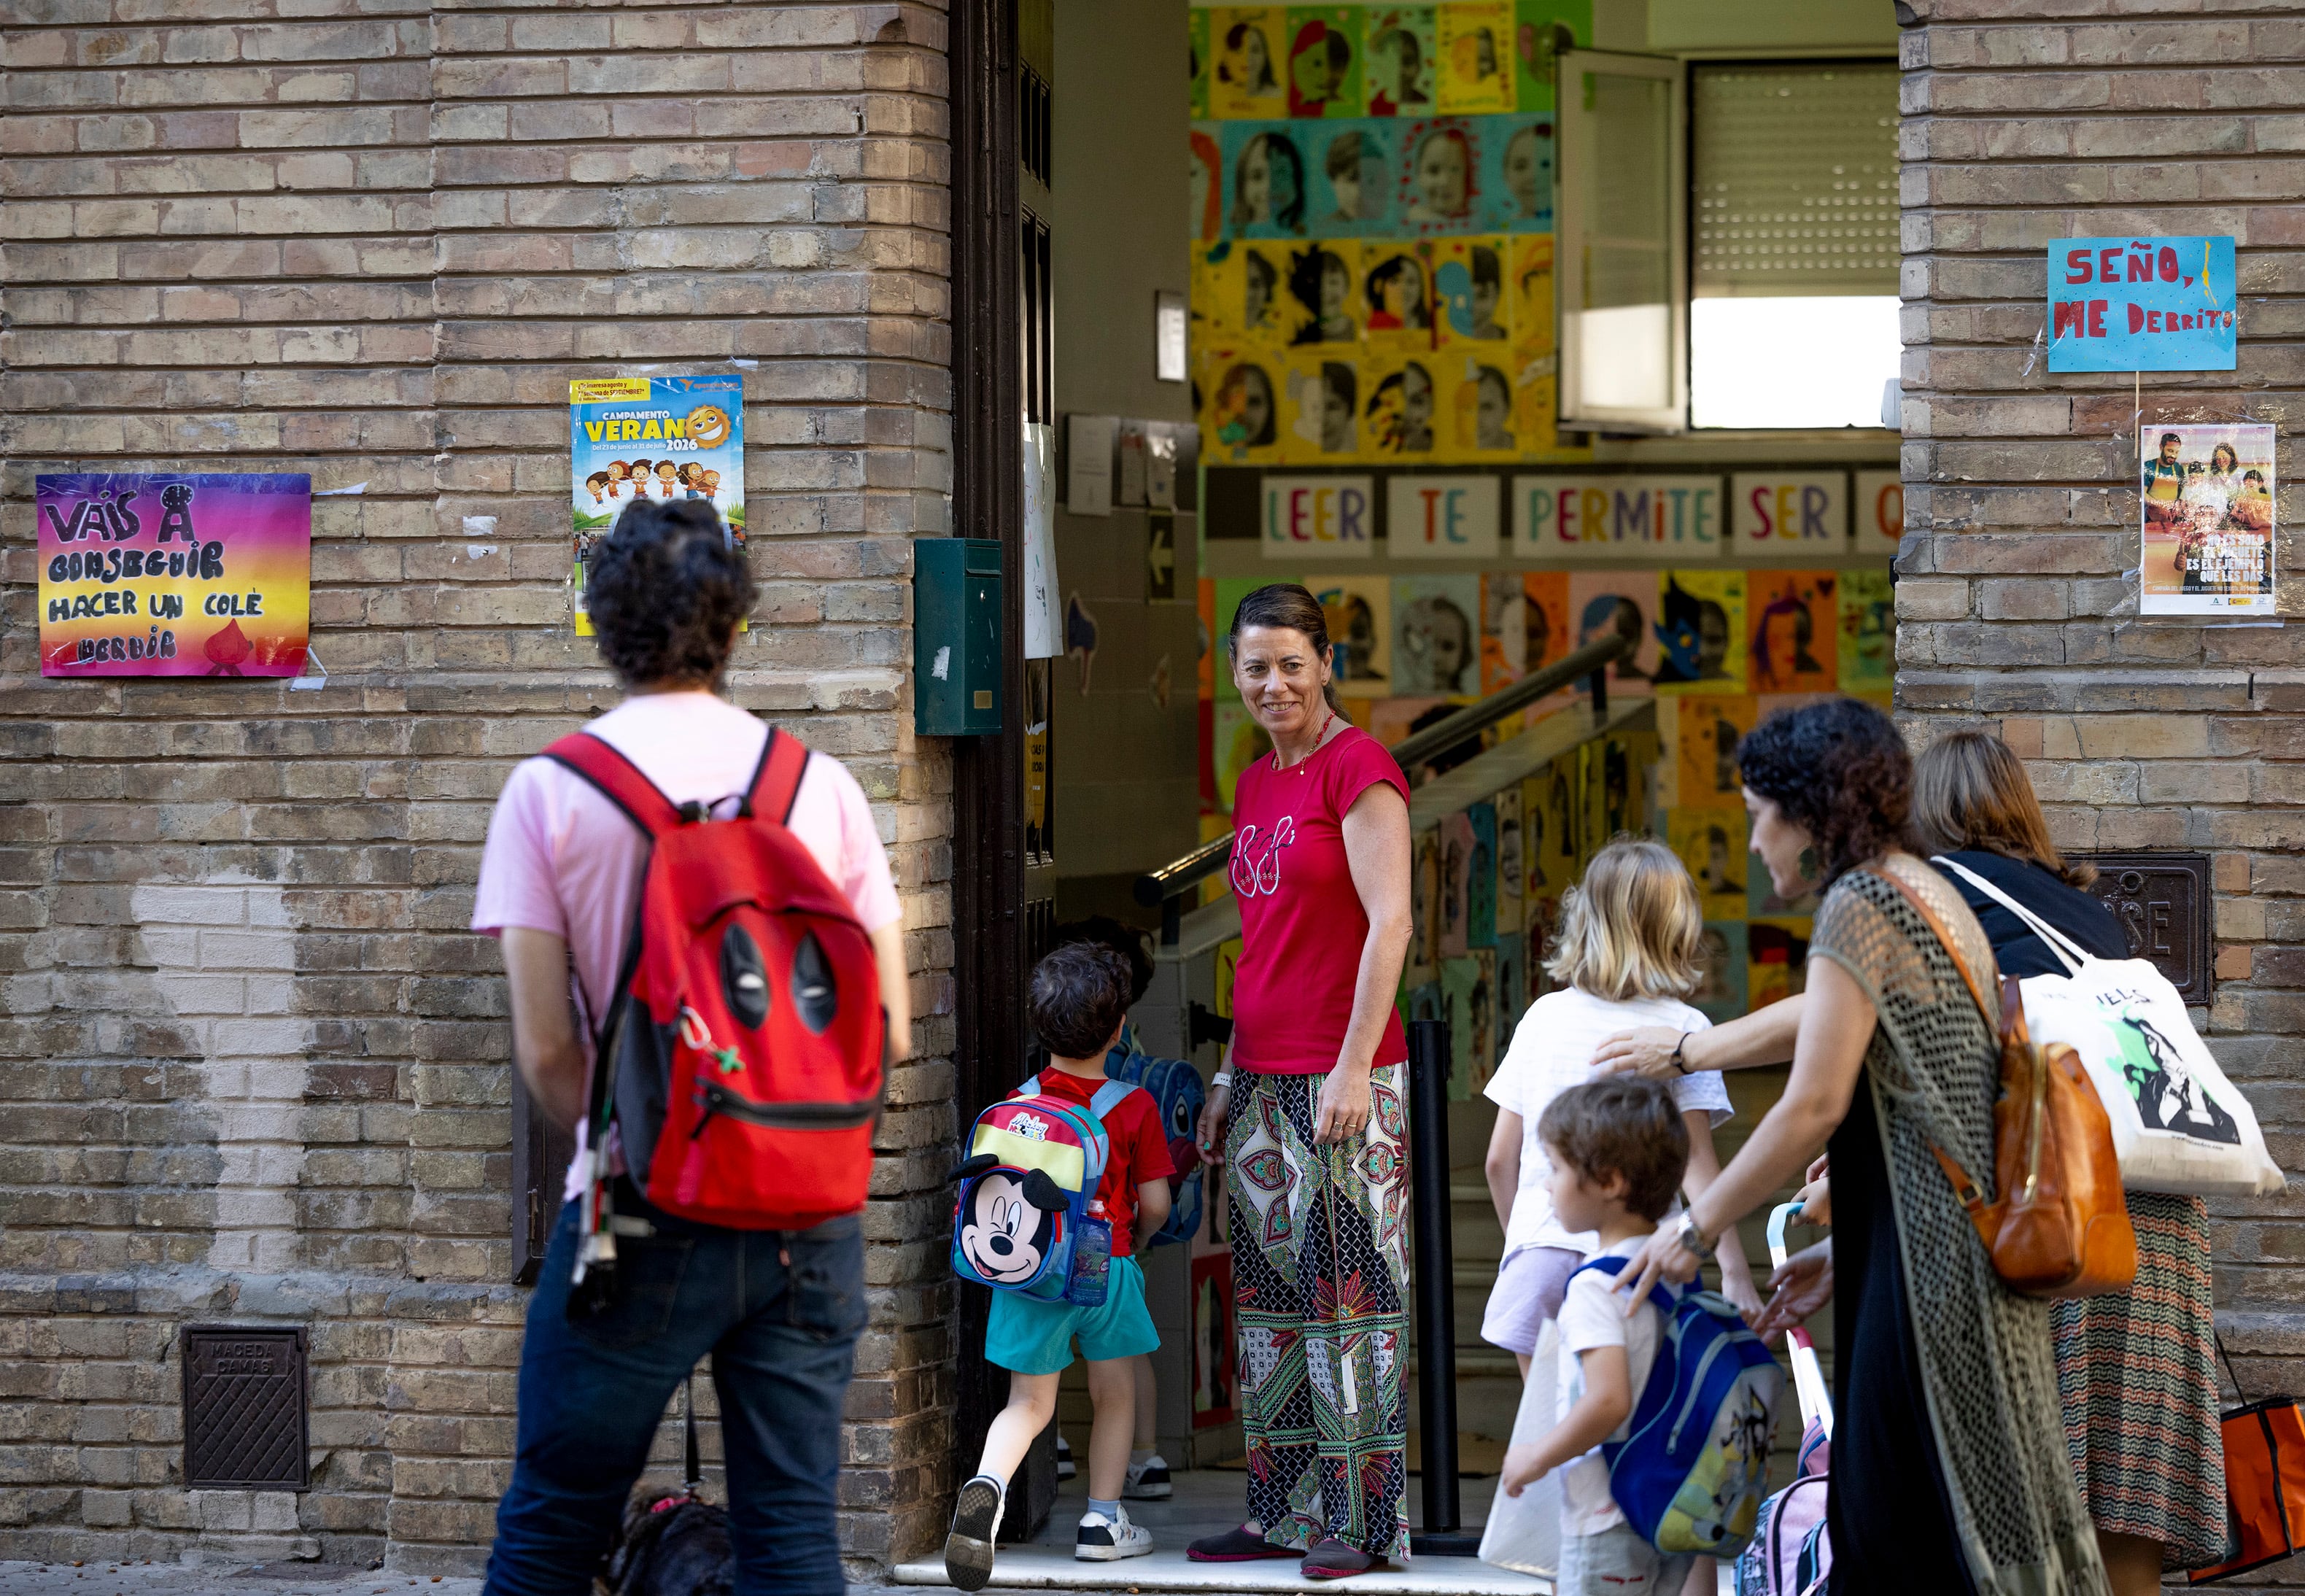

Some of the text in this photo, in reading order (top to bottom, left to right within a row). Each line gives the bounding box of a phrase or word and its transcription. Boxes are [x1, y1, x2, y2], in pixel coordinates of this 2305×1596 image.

[2066, 241, 2194, 289] SEÑO,
[2053, 299, 2108, 338] ME
[602, 410, 670, 420] CAMPAMENTO
[617, 443, 631, 451] junio
[666, 438, 698, 452] 2026
[1267, 487, 1367, 543] LEER
[1418, 488, 1468, 544] TE
[1749, 484, 1829, 541] SER
[2187, 558, 2264, 570] ES EL EJEMPLO
[2200, 570, 2264, 582] QUE LES DAS
[48, 589, 138, 623] HACER
[149, 593, 184, 620] UN
